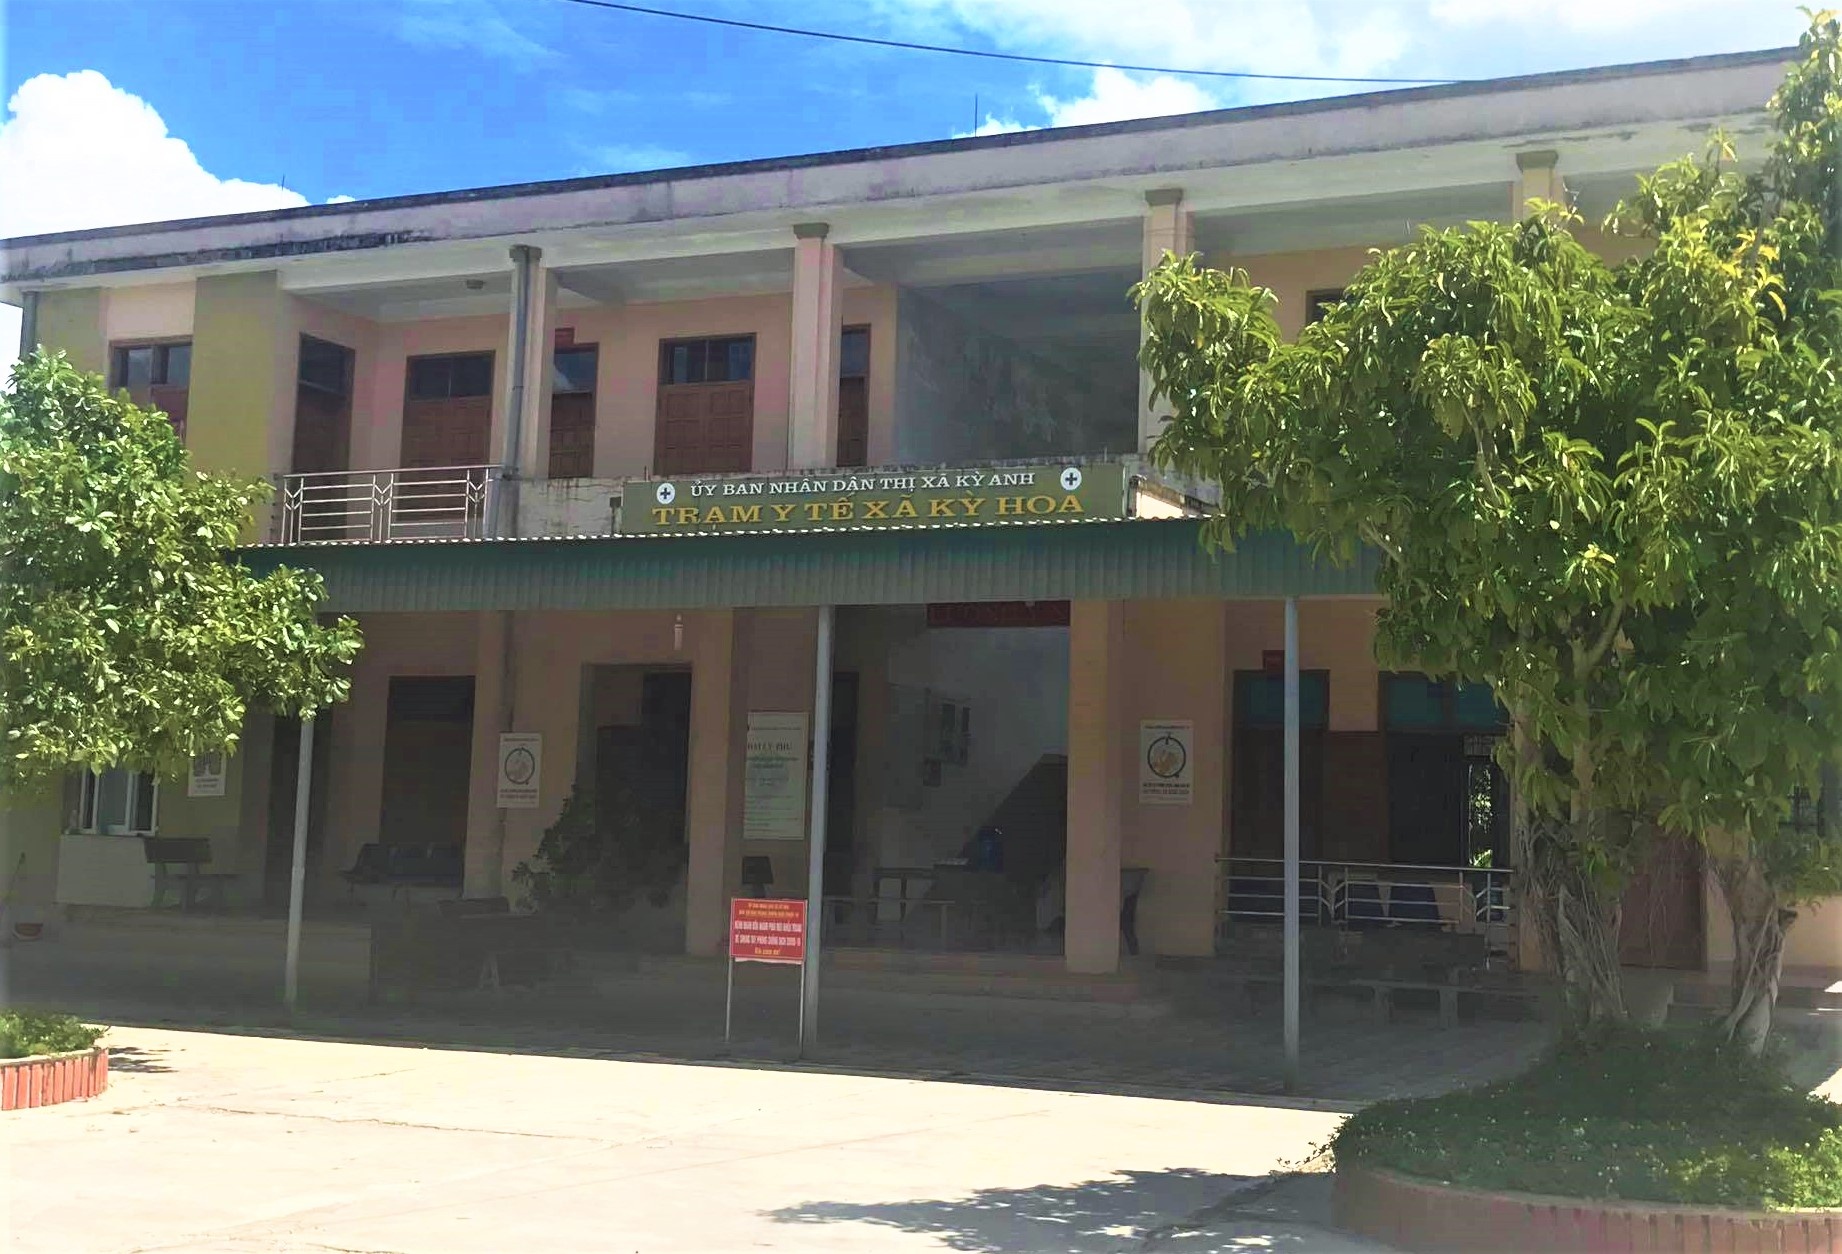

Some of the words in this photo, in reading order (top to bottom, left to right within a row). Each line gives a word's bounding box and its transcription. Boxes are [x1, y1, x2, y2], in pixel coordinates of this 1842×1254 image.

[722, 482, 765, 496] BAN
[769, 478, 829, 495] NHÂN
[832, 476, 875, 492] DÂN
[880, 477, 916, 493] THỊ
[921, 474, 950, 489] XÃ
[955, 471, 985, 487] KỲ
[988, 472, 1036, 486] ANH
[652, 505, 763, 531] TRẠM
[770, 503, 796, 522] Y
[804, 491, 855, 521] TẾ
[860, 494, 919, 519] XÃ
[928, 490, 986, 517] KỲ
[995, 495, 1085, 515] HOA
